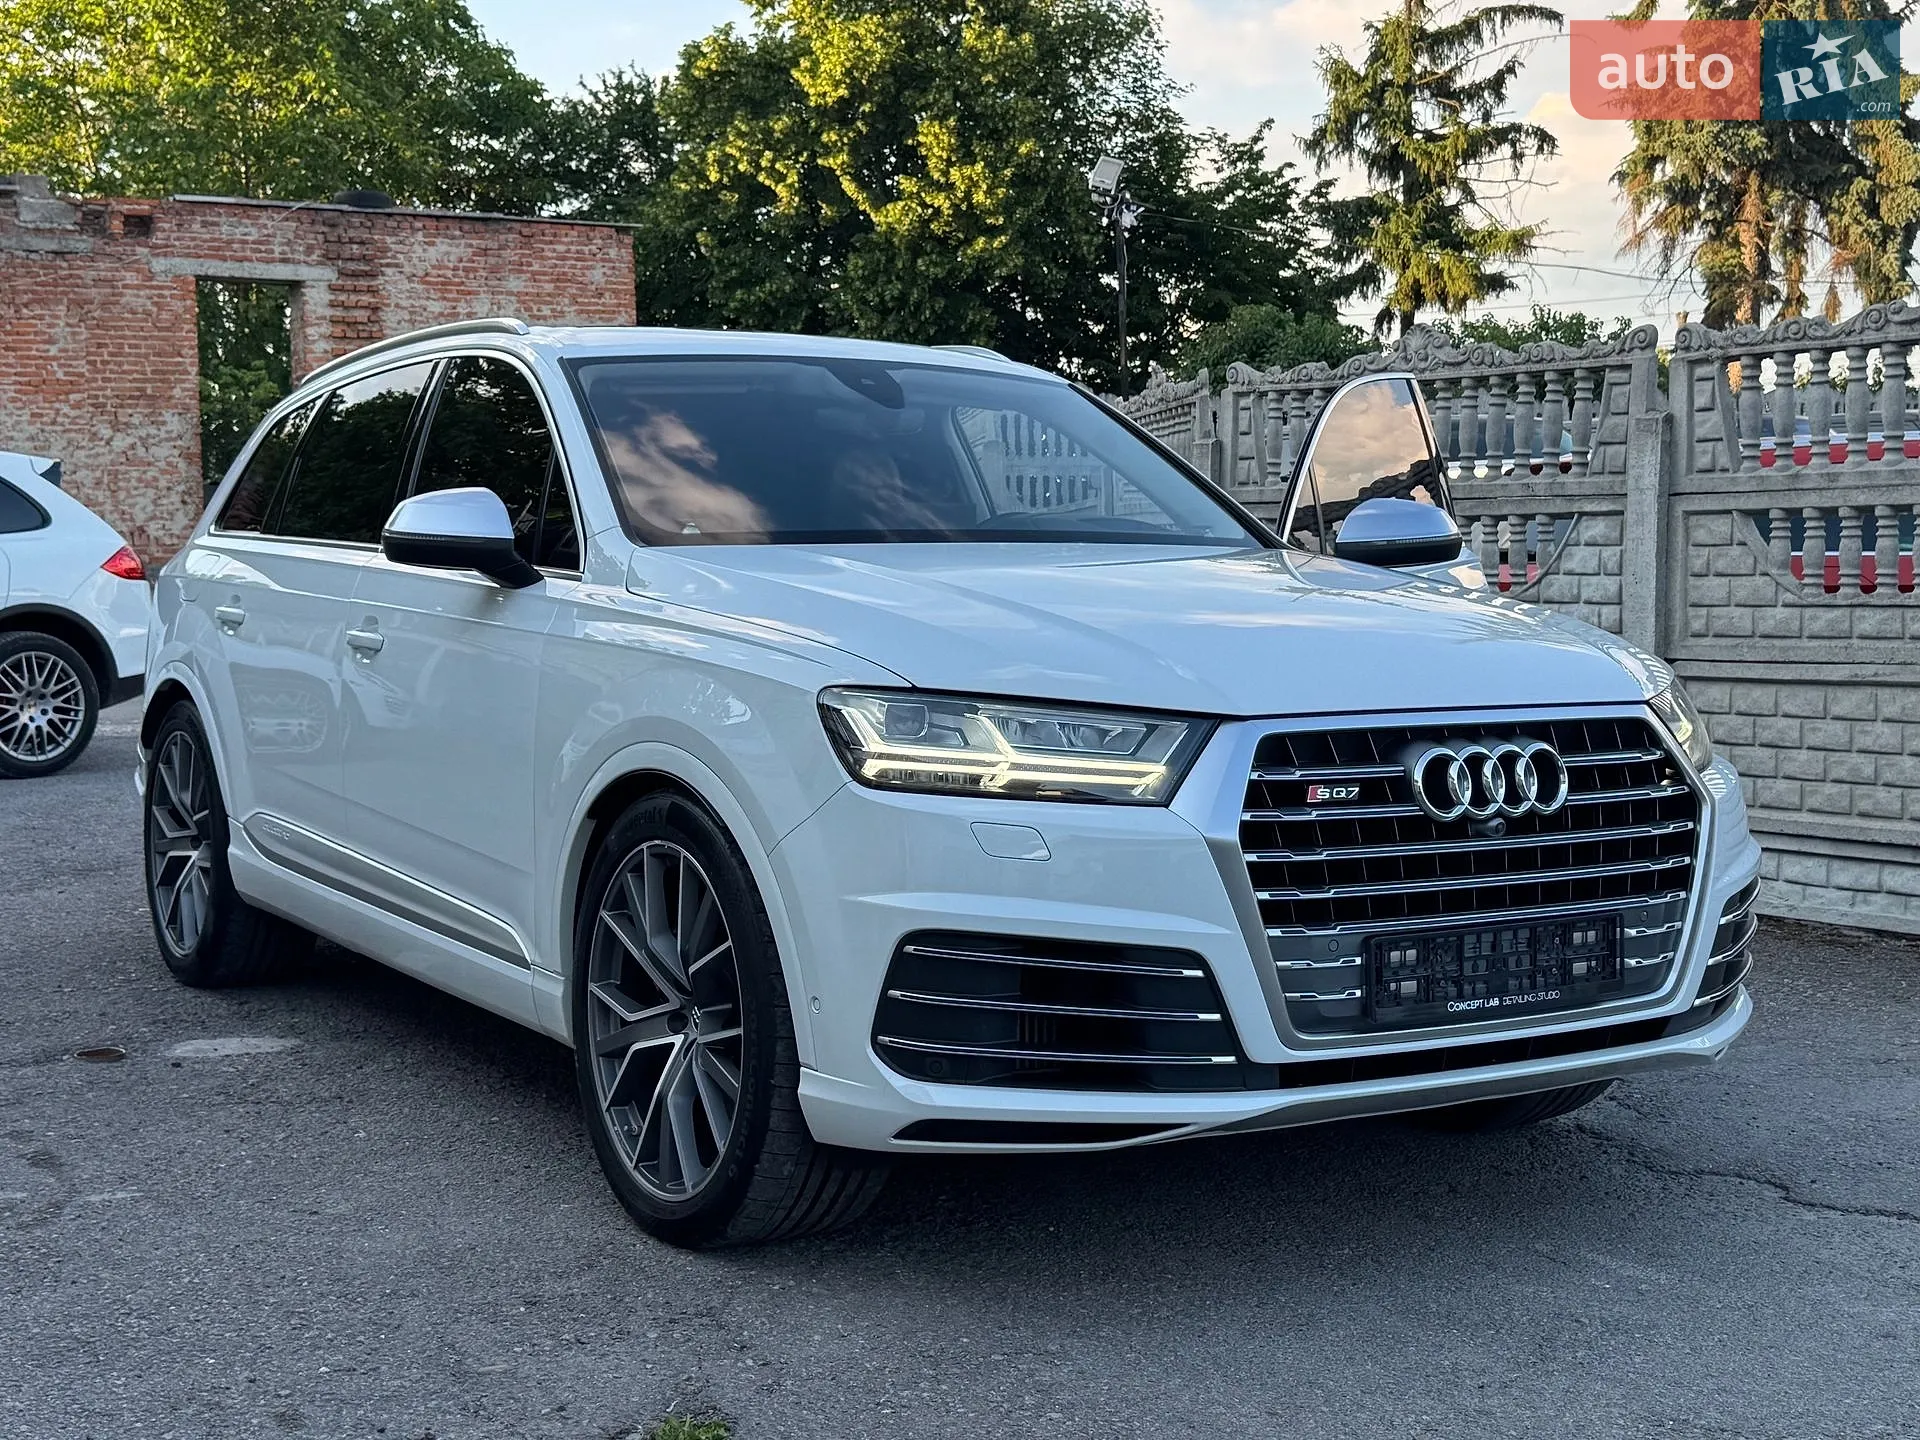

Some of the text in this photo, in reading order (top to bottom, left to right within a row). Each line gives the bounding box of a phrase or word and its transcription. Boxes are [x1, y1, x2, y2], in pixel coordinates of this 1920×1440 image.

[1315, 787, 1360, 799] SQ7
[1447, 998, 1483, 1012] CONCEPT
[1484, 997, 1500, 1008] LAB
[1537, 989, 1561, 1001] STUDIO
